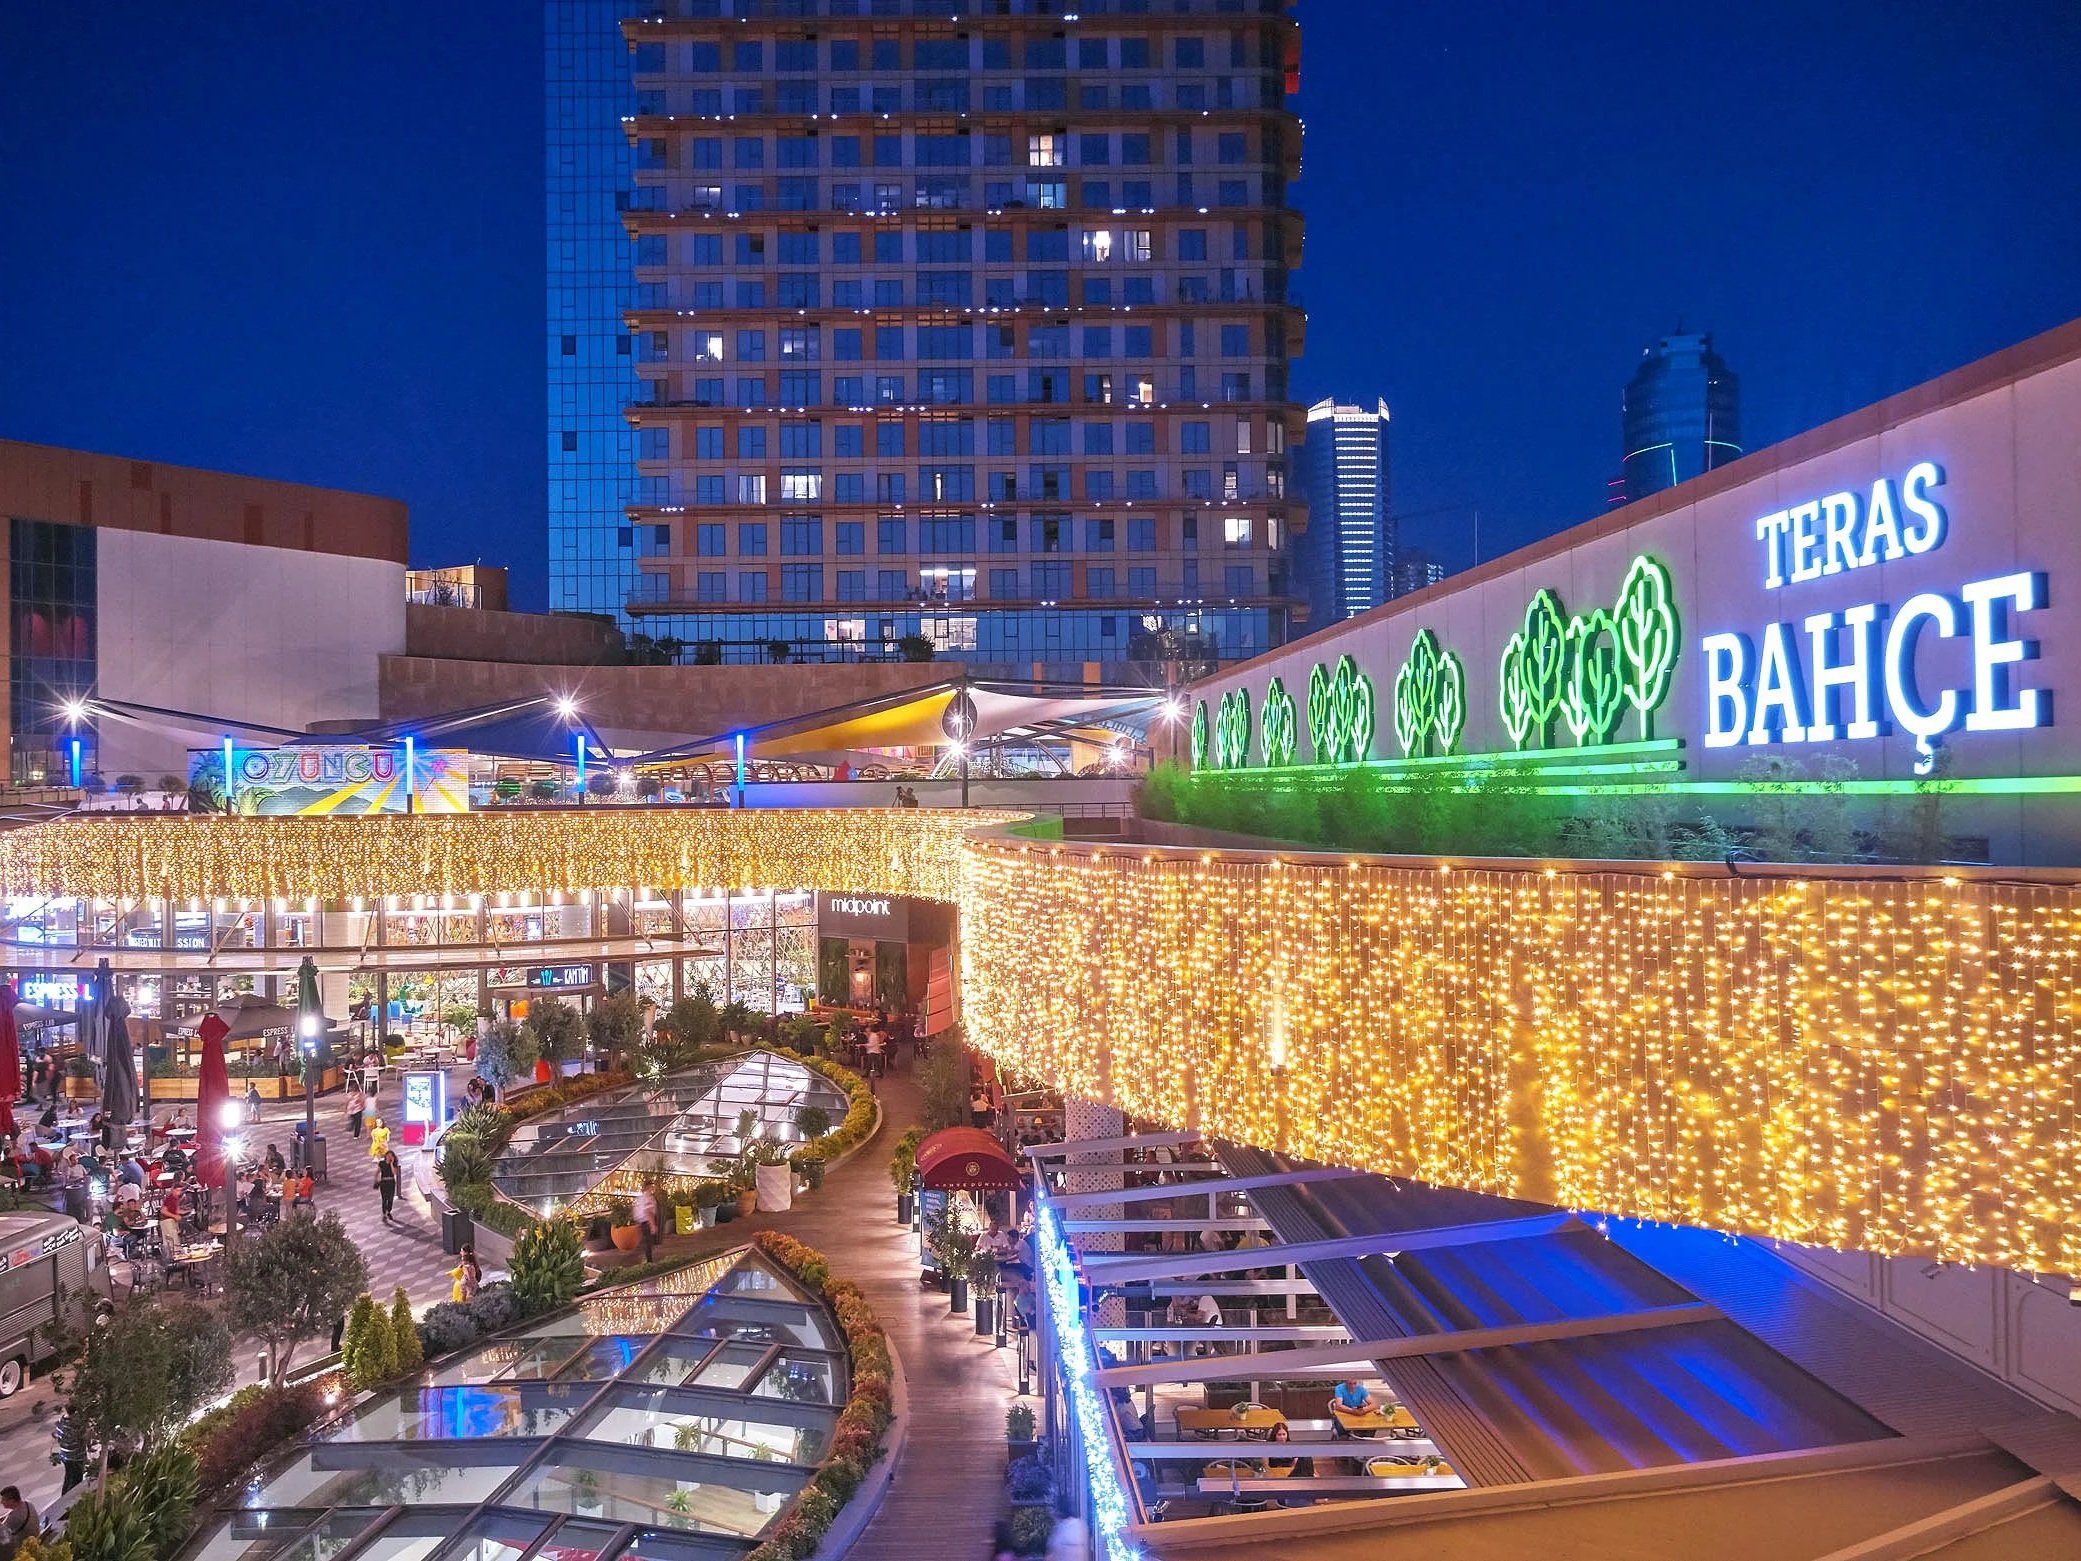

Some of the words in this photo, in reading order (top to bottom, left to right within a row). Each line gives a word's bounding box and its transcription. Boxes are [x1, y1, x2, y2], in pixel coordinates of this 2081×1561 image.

[1756, 462, 1946, 590] TERAS
[1702, 572, 2050, 775] BAHÇE
[831, 896, 890, 917] midpoint
[263, 1026, 288, 1038] ESPRESS
